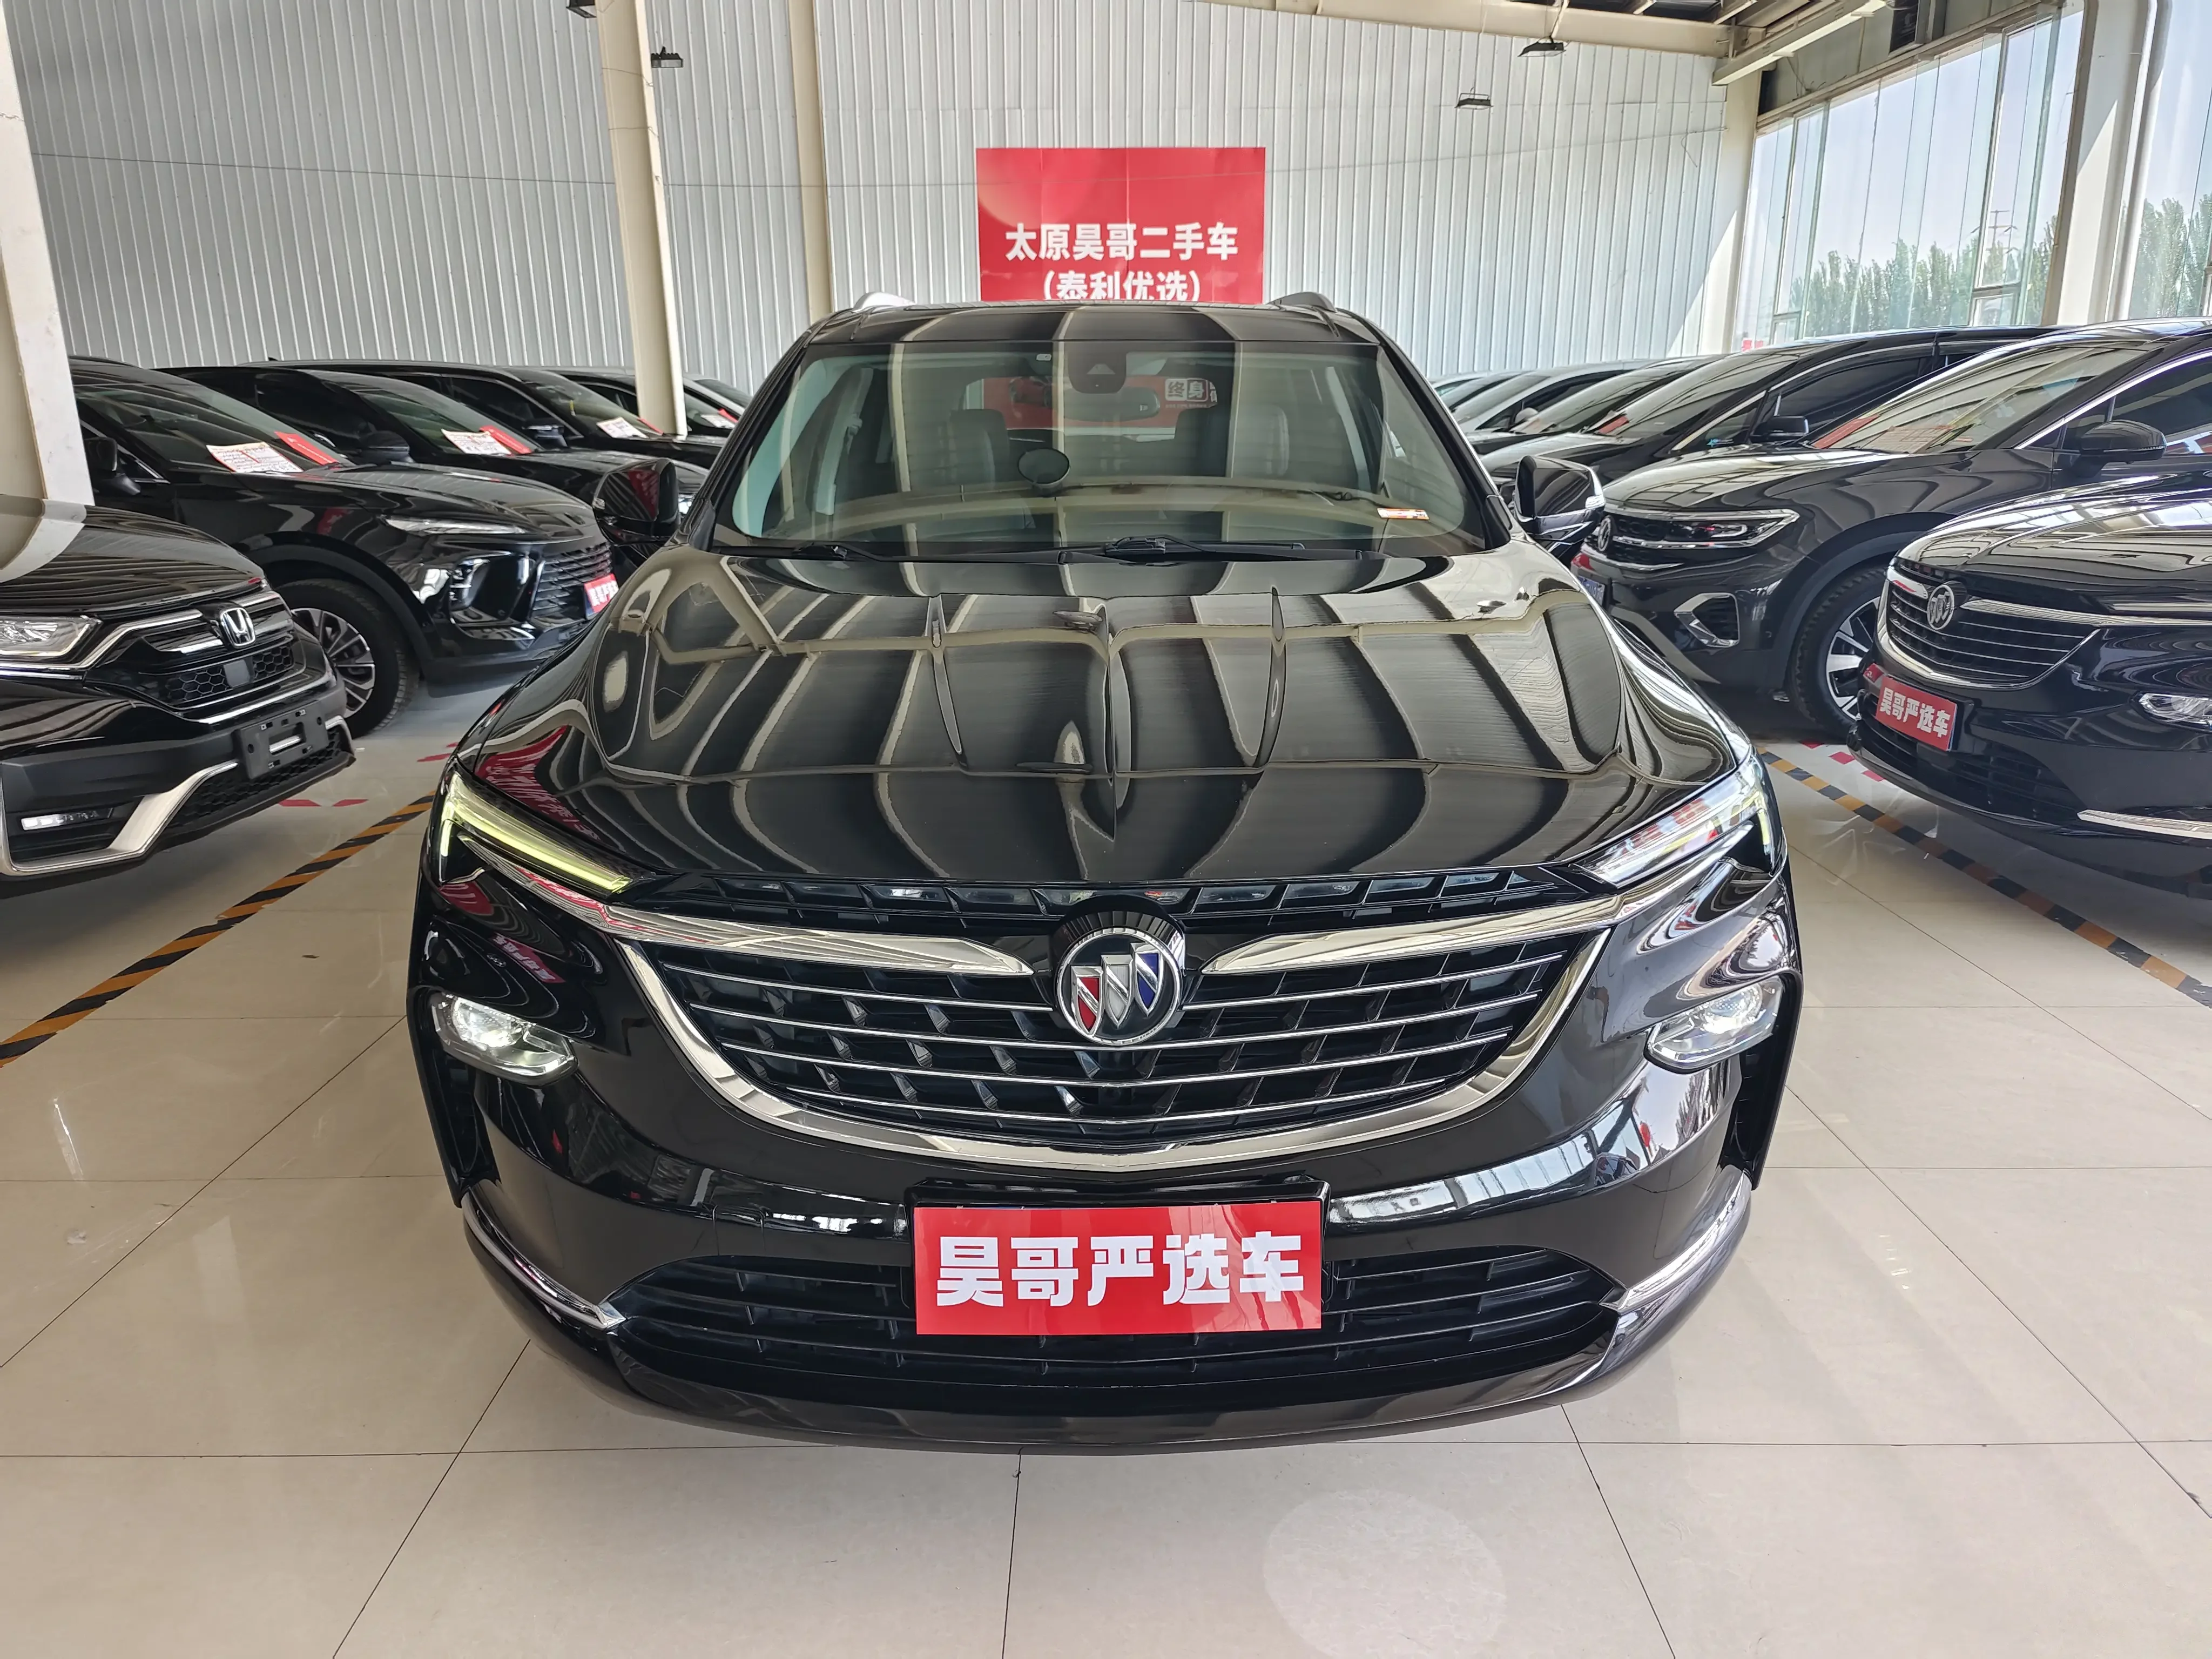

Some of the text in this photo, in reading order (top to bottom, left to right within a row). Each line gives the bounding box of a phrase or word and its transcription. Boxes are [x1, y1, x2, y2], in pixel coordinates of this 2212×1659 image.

[1005, 222, 1238, 261] 太原昊哥二手车
[1879, 686, 1951, 738] 昊哥严选车
[936, 1231, 1304, 1307] 昊哥严选车
